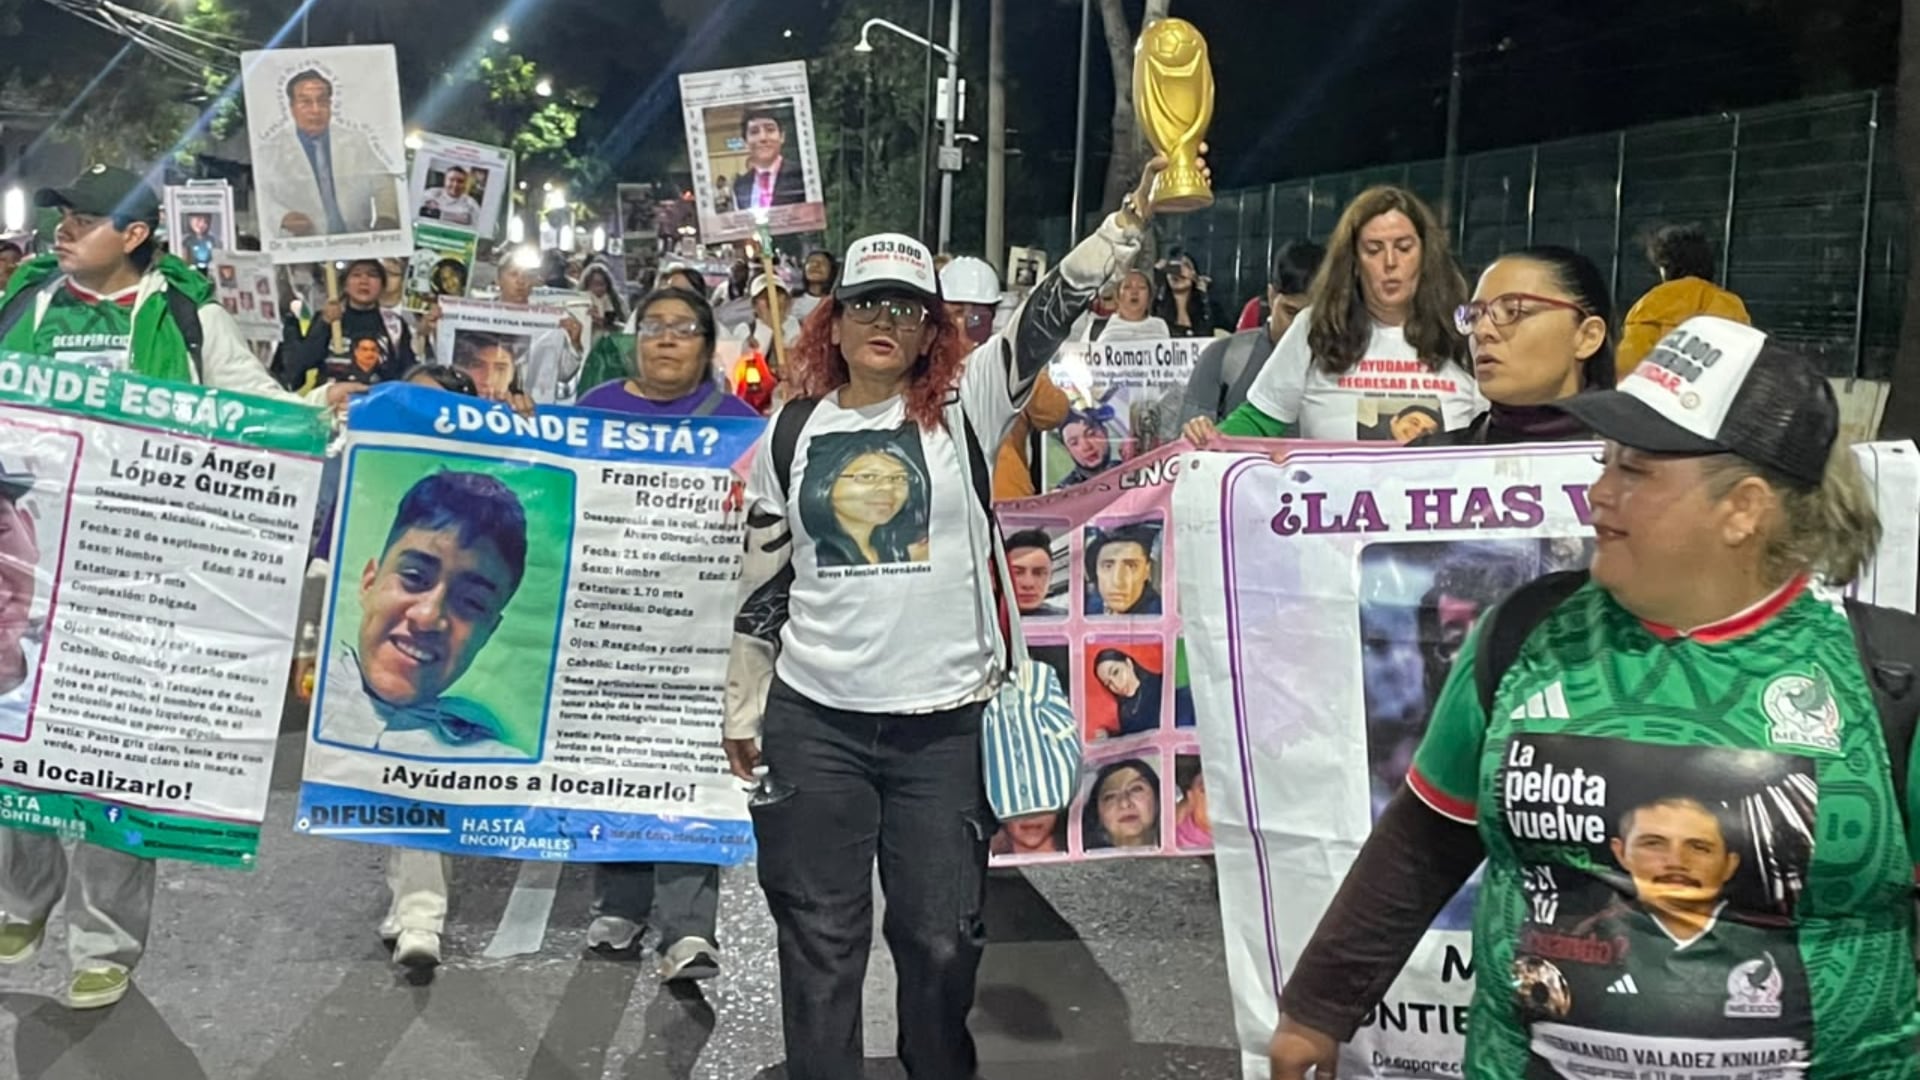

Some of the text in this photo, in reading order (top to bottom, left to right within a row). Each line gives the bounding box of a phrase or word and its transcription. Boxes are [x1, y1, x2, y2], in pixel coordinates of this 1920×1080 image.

[872, 240, 923, 260] 133,000
[1155, 343, 1187, 366] Colin
[1423, 378, 1457, 393] CASA
[120, 379, 246, 433] ESTÁ?
[433, 403, 720, 456] ¿DÓNDE ESTÁ?
[141, 439, 276, 480] Luis Ángel
[110, 459, 298, 508] López Guzmán
[602, 468, 705, 491] Francisco
[186, 501, 229, 518] Colonia
[232, 510, 245, 521] La
[247, 513, 299, 531] Conchita
[1270, 488, 1389, 536] ¿LA
[1406, 484, 1545, 531] HAS
[78, 540, 164, 564] Sexo: Hombre
[80, 520, 284, 566] Fecha: 26 de septiembre de 2018
[582, 544, 620, 559] Fecha:
[623, 549, 640, 560] 21
[659, 552, 715, 564] diciembre
[718, 555, 731, 564] de
[74, 560, 131, 579] Estatura:
[202, 560, 287, 586] Edad: años
[581, 562, 661, 578] Sexo: Hombre
[71, 579, 197, 612] Complexión: Delgada
[578, 581, 684, 600] Estatura: 1.70 mts
[96, 606, 145, 623] Morena
[574, 599, 694, 618] Complexión: Delgada
[573, 618, 643, 633] Tez: Morena
[60, 641, 110, 661] Cabello:
[570, 637, 599, 650] Ojos:
[602, 638, 657, 653] Rasgados
[669, 643, 693, 655] café
[566, 657, 613, 671] Cabello:
[616, 660, 647, 672] Lacio
[658, 664, 690, 676] negro
[1509, 740, 1536, 768] La
[13, 759, 193, 801] a localizarlo!
[382, 765, 697, 802] ¡Ayúdanos a localizarlo!
[1505, 764, 1607, 809] pelota
[310, 803, 446, 828] DIFUSIÓN
[462, 818, 526, 834] HASTA
[1507, 805, 1606, 844] vuelve
[460, 834, 571, 851] ENCONTRARLES
[1372, 1050, 1464, 1076] Desaparec
[1633, 1048, 1716, 1069] VALADEZ
